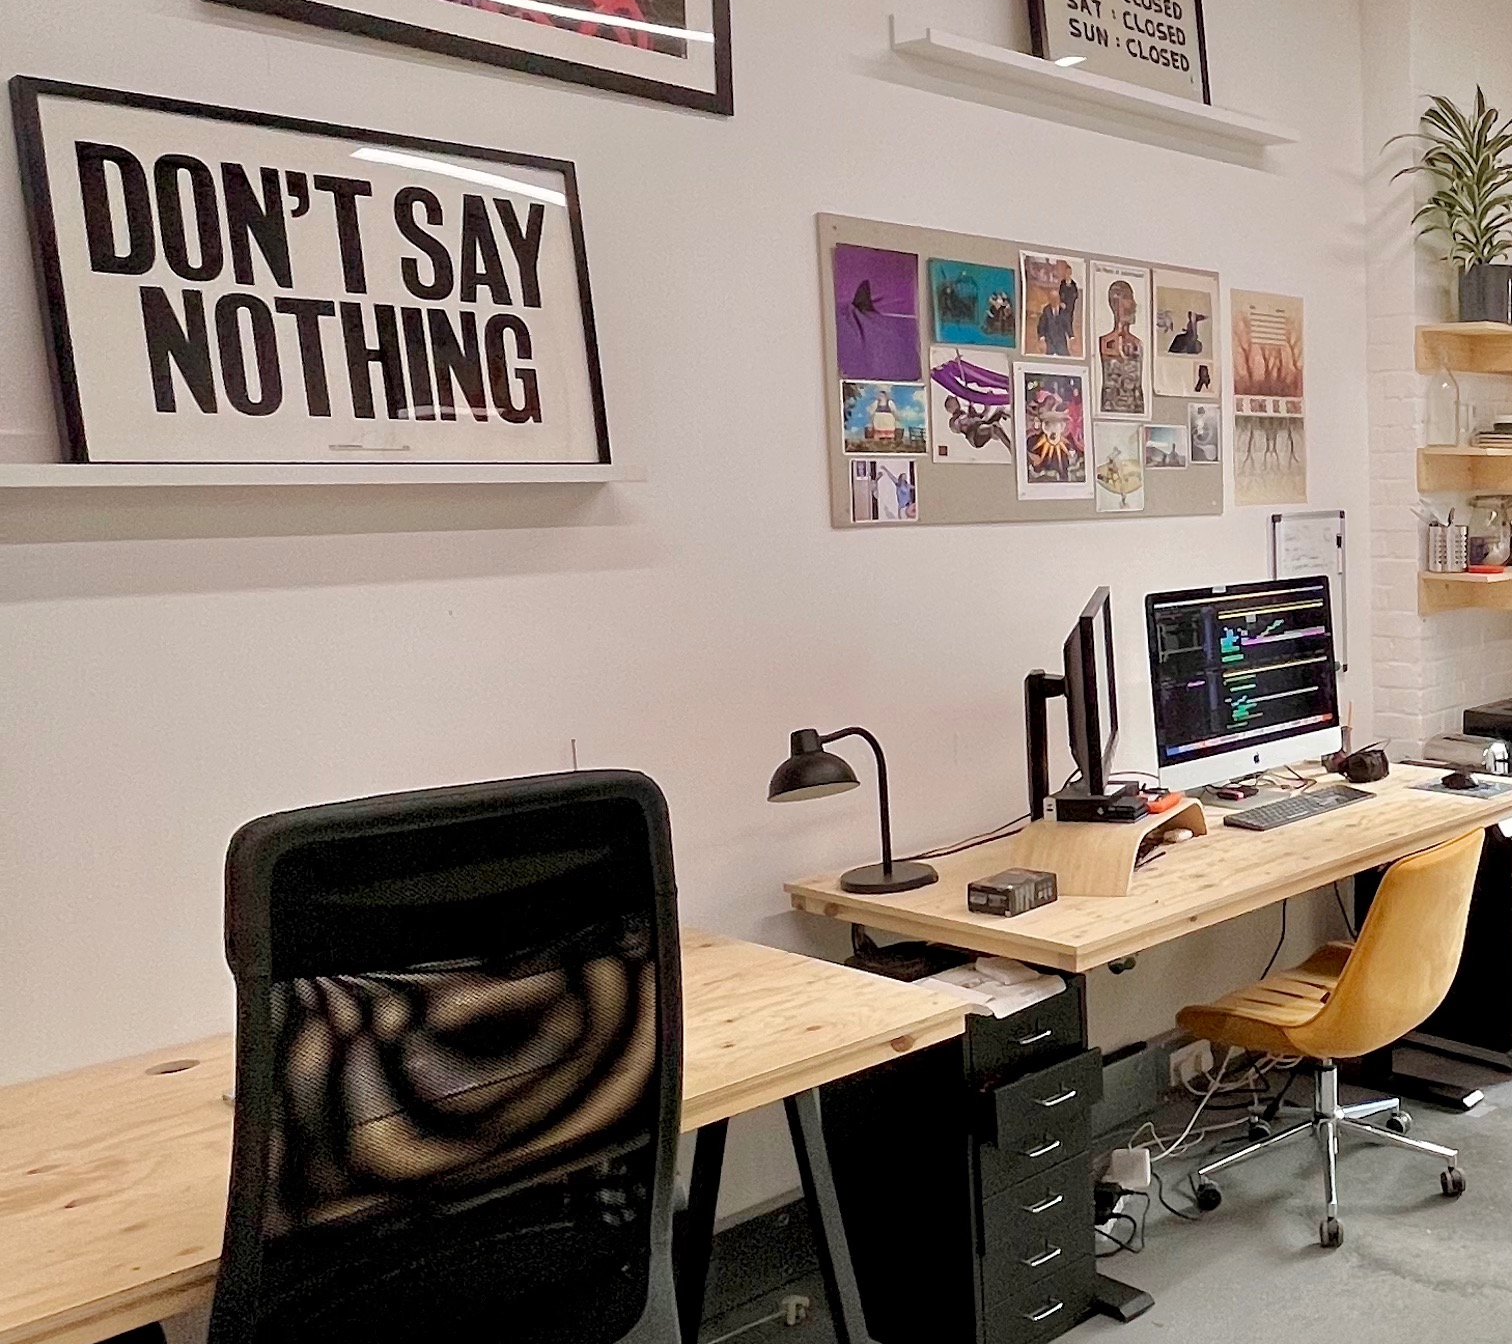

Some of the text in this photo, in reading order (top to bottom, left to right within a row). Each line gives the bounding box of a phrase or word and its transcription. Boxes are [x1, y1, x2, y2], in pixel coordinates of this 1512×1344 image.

[1122, 10, 1186, 47] CLOSED
[1125, 37, 1190, 72] CLOSED
[75, 140, 546, 309] DON'T SAY
[138, 284, 544, 424] NOTHING
